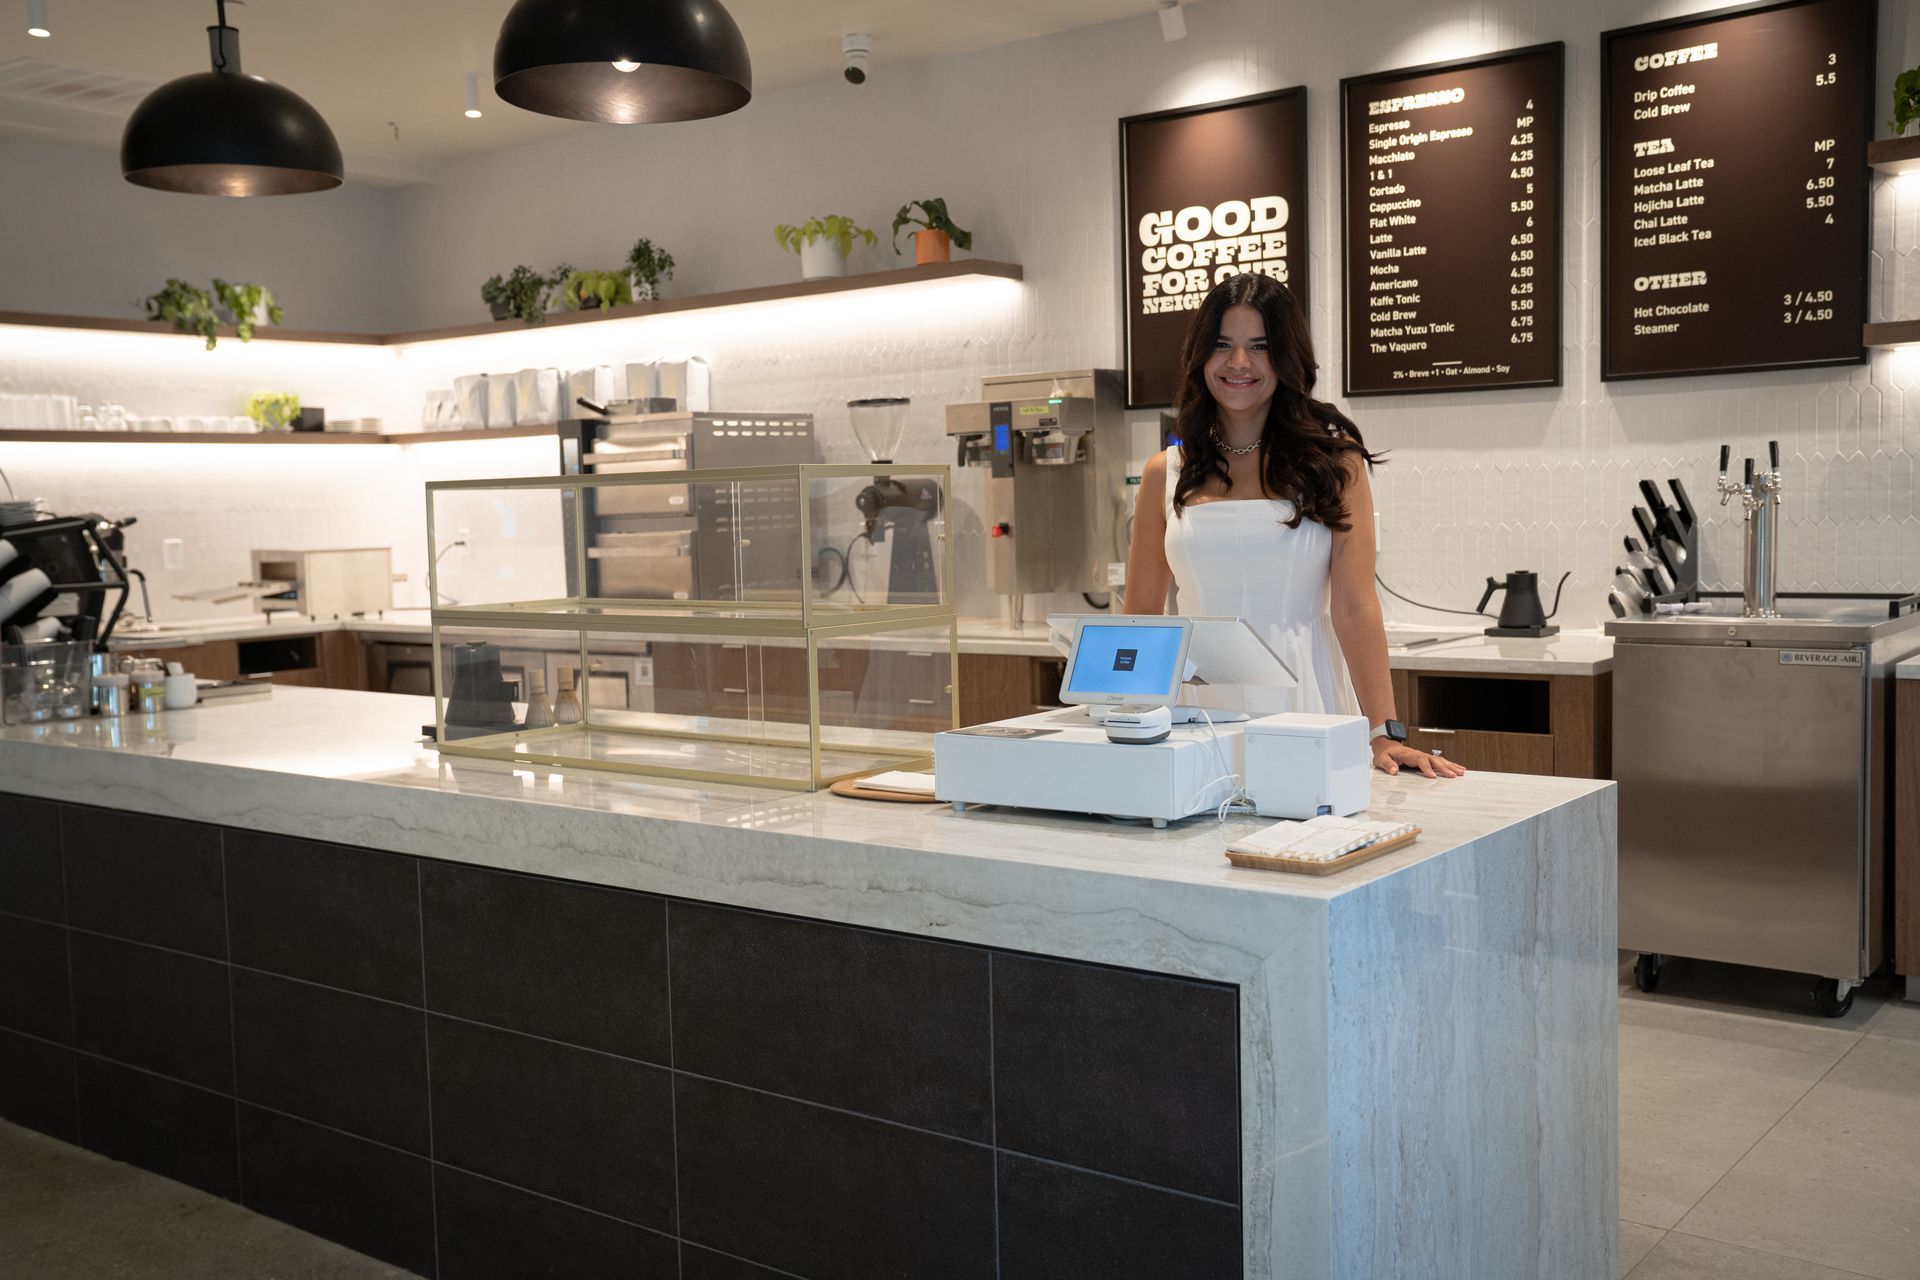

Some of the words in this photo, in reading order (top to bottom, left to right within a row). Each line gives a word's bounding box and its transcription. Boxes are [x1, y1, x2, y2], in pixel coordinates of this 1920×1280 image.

[1634, 43, 1718, 71] COFFEE
[1816, 72, 1836, 86] 5.5
[1634, 90, 1658, 102] Drip
[1660, 84, 1695, 98] Coffee
[1369, 87, 1465, 116] ESPRESSO
[1634, 106, 1658, 120] Cold
[1661, 103, 1690, 116] Brew
[1369, 120, 1410, 134] Espresso
[1517, 116, 1533, 128] MP
[1370, 137, 1398, 150] Single
[1399, 132, 1428, 145] Origin
[1430, 127, 1473, 142] Espresso
[1511, 133, 1533, 145] 4.25
[1634, 138, 1674, 157] TEA
[1815, 140, 1835, 152] MP
[1370, 152, 1415, 165] Macchiato
[1511, 150, 1533, 162] 4.25
[1511, 167, 1533, 178] 4.50
[1634, 166, 1665, 178] Loose
[1668, 160, 1691, 173] Leaf
[1694, 158, 1714, 169] Tea
[1370, 184, 1405, 196] Cortado
[1634, 182, 1672, 195] Matcha
[1676, 178, 1703, 190] Latte
[1806, 177, 1834, 190] 6.50
[1370, 198, 1421, 213] Cappuccino
[1511, 200, 1533, 212] 5.50
[1634, 199, 1673, 213] Hojicha
[1676, 196, 1704, 207] Latte
[1806, 195, 1834, 208] 5.50
[1139, 196, 1289, 247] GOOD
[1370, 218, 1387, 228] Flat
[1389, 215, 1416, 226] White
[1634, 218, 1657, 230] Chai
[1660, 216, 1688, 226] Latte
[1370, 234, 1392, 244] Latte
[1511, 234, 1533, 245] 6.50
[1634, 235, 1656, 247] Iced
[1659, 232, 1688, 244] Black
[1691, 230, 1711, 240] Tea
[1142, 231, 1287, 273] COFFEE
[1370, 248, 1401, 259] Vanilla
[1404, 246, 1426, 256] Latte
[1511, 250, 1533, 261] 6.50
[1370, 264, 1399, 275] Mocha
[1511, 266, 1533, 277] 4.50
[1143, 268, 1209, 297] FOR
[1370, 280, 1418, 291] Americano
[1634, 271, 1707, 291] OTHER
[1511, 283, 1533, 294] 6.25
[1371, 296, 1394, 306] Kaffe
[1396, 294, 1420, 304] Tonic
[1805, 291, 1832, 302] 4.50
[1512, 300, 1533, 310] 5.50
[1634, 308, 1652, 318] Hot
[1656, 303, 1709, 316] Chocolate
[1370, 312, 1390, 322] Cold
[1393, 311, 1416, 320] Brew
[1511, 316, 1533, 327] 6.75
[1805, 309, 1832, 321] 4.50
[1371, 327, 1402, 337] Matcha
[1405, 326, 1427, 334] Yuzu
[1429, 322, 1454, 332] Tonic
[1634, 324, 1679, 335] Steamer
[1511, 332, 1533, 343] 6.75
[1370, 344, 1387, 353] The
[1389, 342, 1426, 352] Vaquero
[1410, 370, 1429, 378] Breve
[1463, 366, 1490, 374] Almond
[1496, 365, 1510, 373] Soy
[1794, 653, 1857, 663] BEVERAGE-AIR
